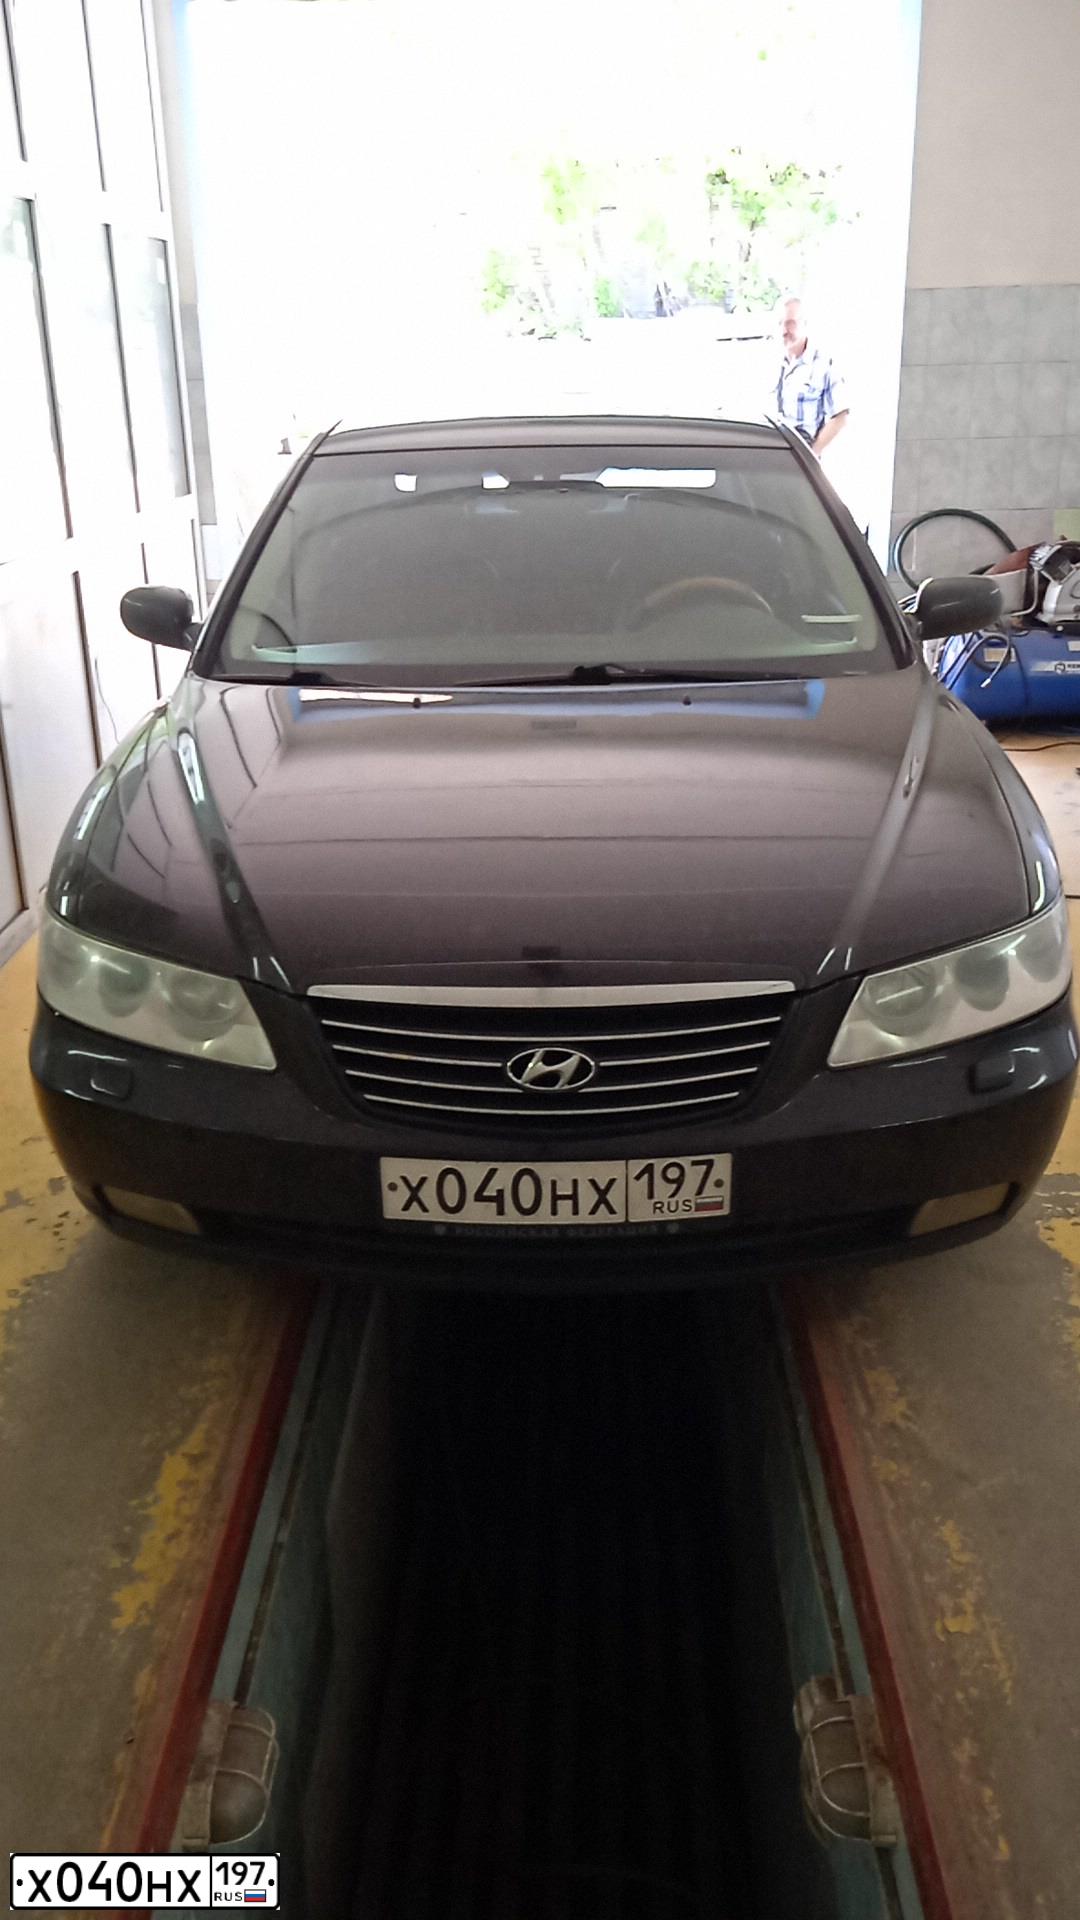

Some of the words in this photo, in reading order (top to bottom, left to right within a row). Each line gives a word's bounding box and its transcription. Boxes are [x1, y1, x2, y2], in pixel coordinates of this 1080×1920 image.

[400, 1167, 617, 1216] Х040НХ
[634, 1159, 714, 1200] 197
[653, 1200, 693, 1214] RUS
